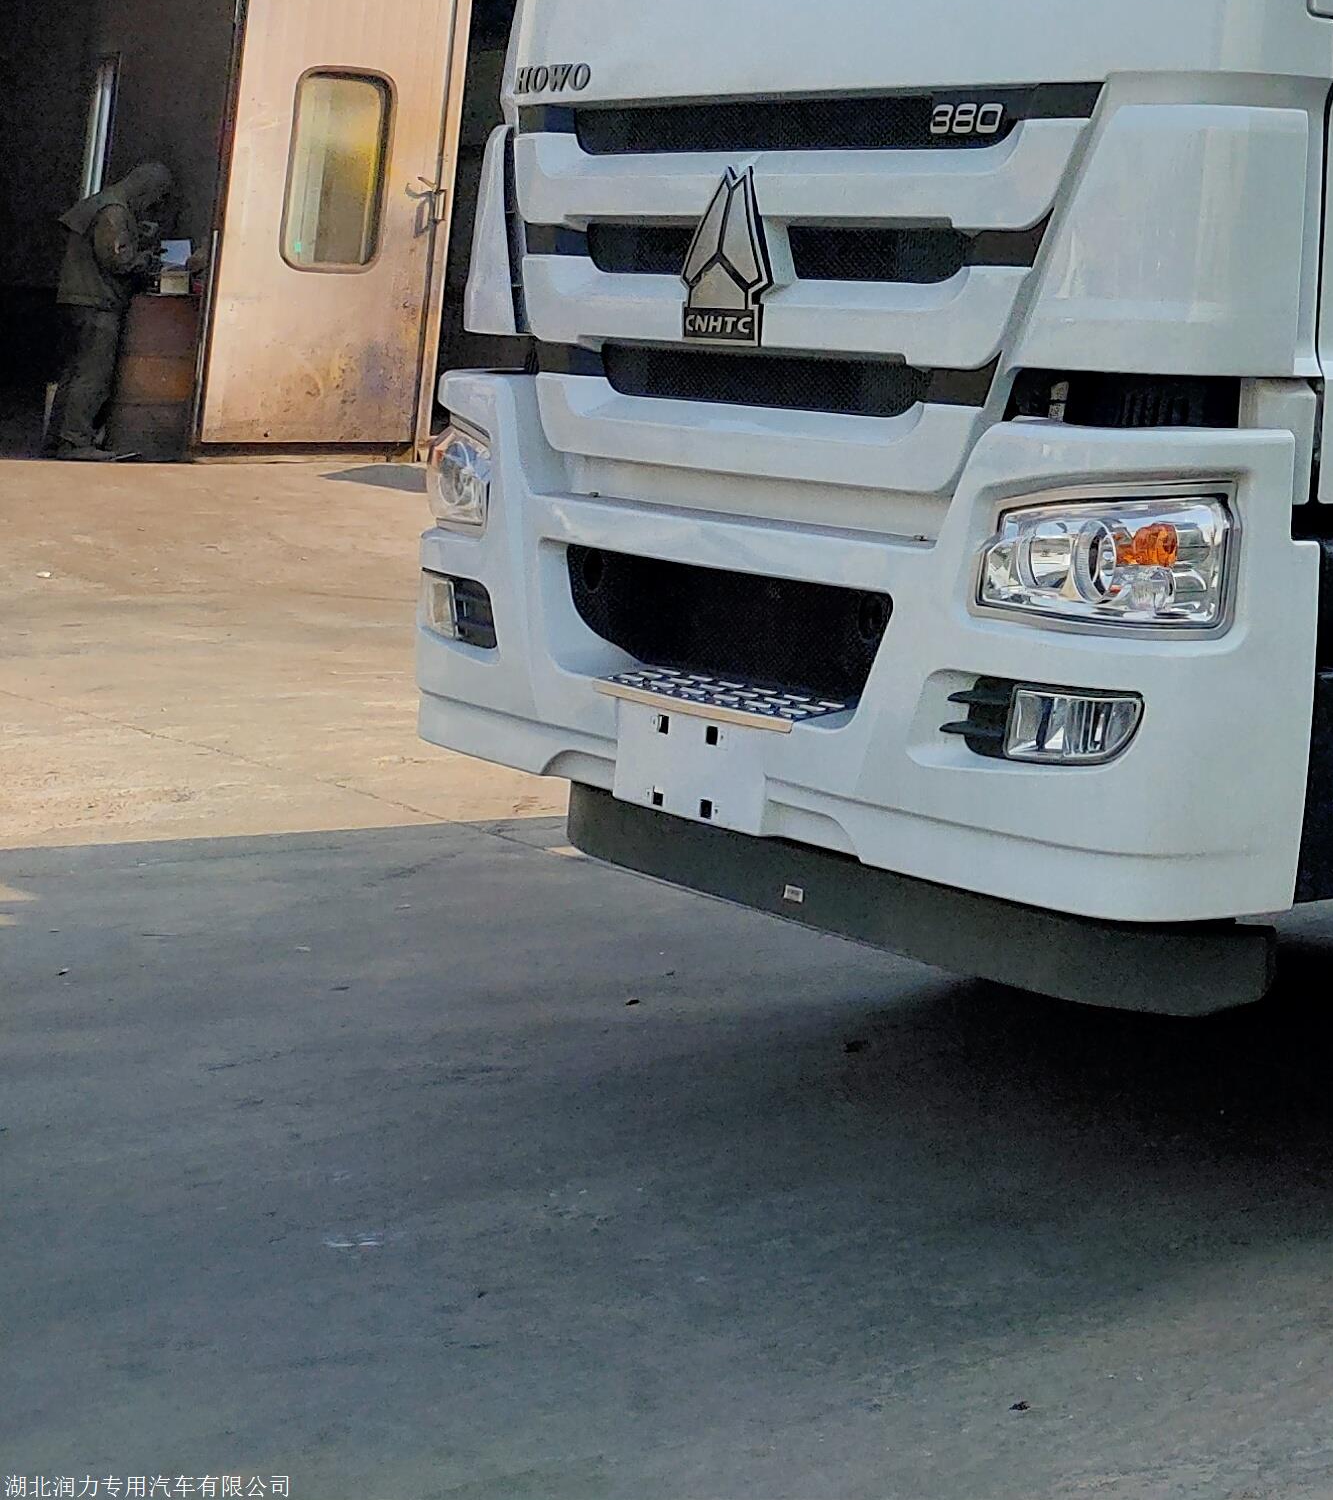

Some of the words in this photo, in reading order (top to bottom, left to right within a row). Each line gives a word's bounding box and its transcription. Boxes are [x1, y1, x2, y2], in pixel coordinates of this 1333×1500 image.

[513, 62, 591, 95] HOWO
[930, 103, 1004, 134] 380
[685, 314, 753, 334] CNHTC
